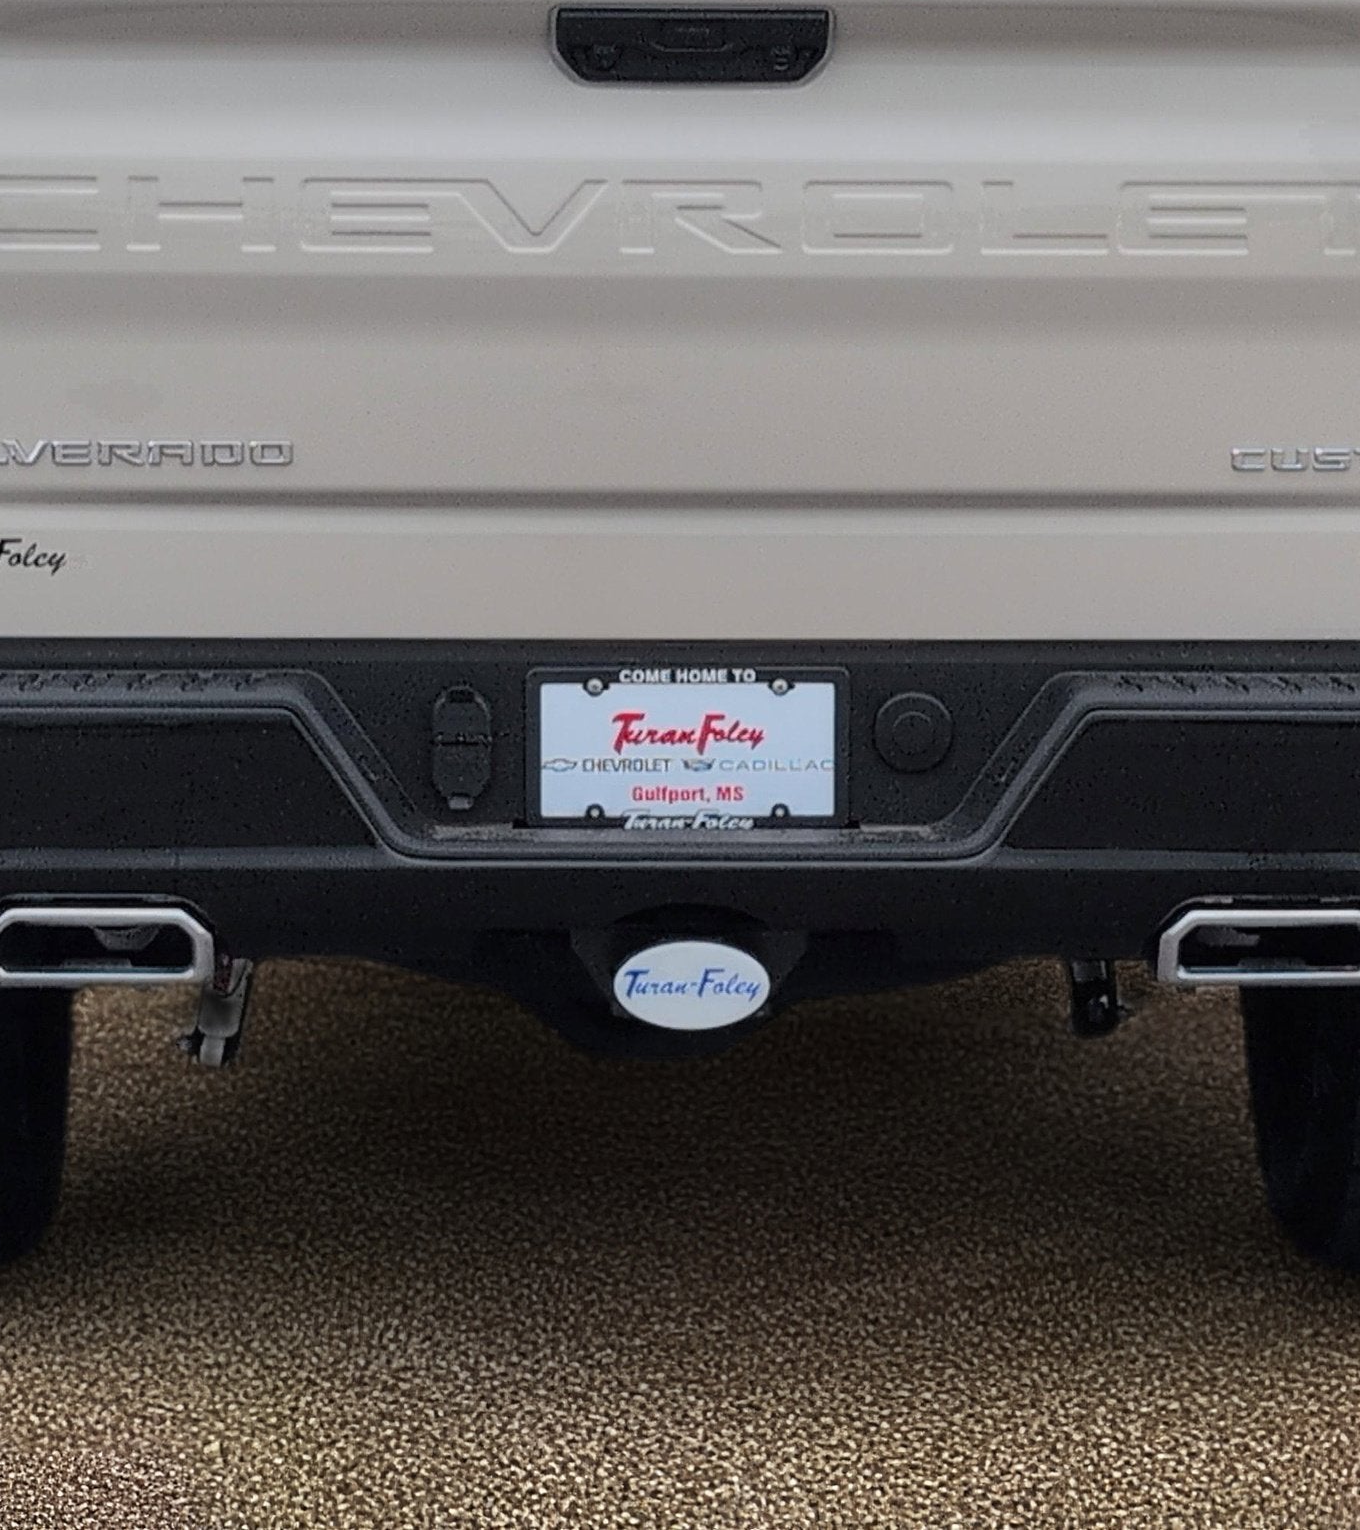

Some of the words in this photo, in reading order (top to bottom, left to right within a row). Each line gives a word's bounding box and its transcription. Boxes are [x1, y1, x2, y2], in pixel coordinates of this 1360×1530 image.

[619, 668, 671, 684] COME
[675, 668, 728, 684] HOME
[732, 668, 757, 684] TO
[581, 757, 673, 773] CHEVROLET
[718, 758, 837, 772] CADILLAC
[632, 785, 712, 805] Gulfport,
[716, 785, 745, 802] MS
[623, 968, 763, 1002] Turan-Foley
